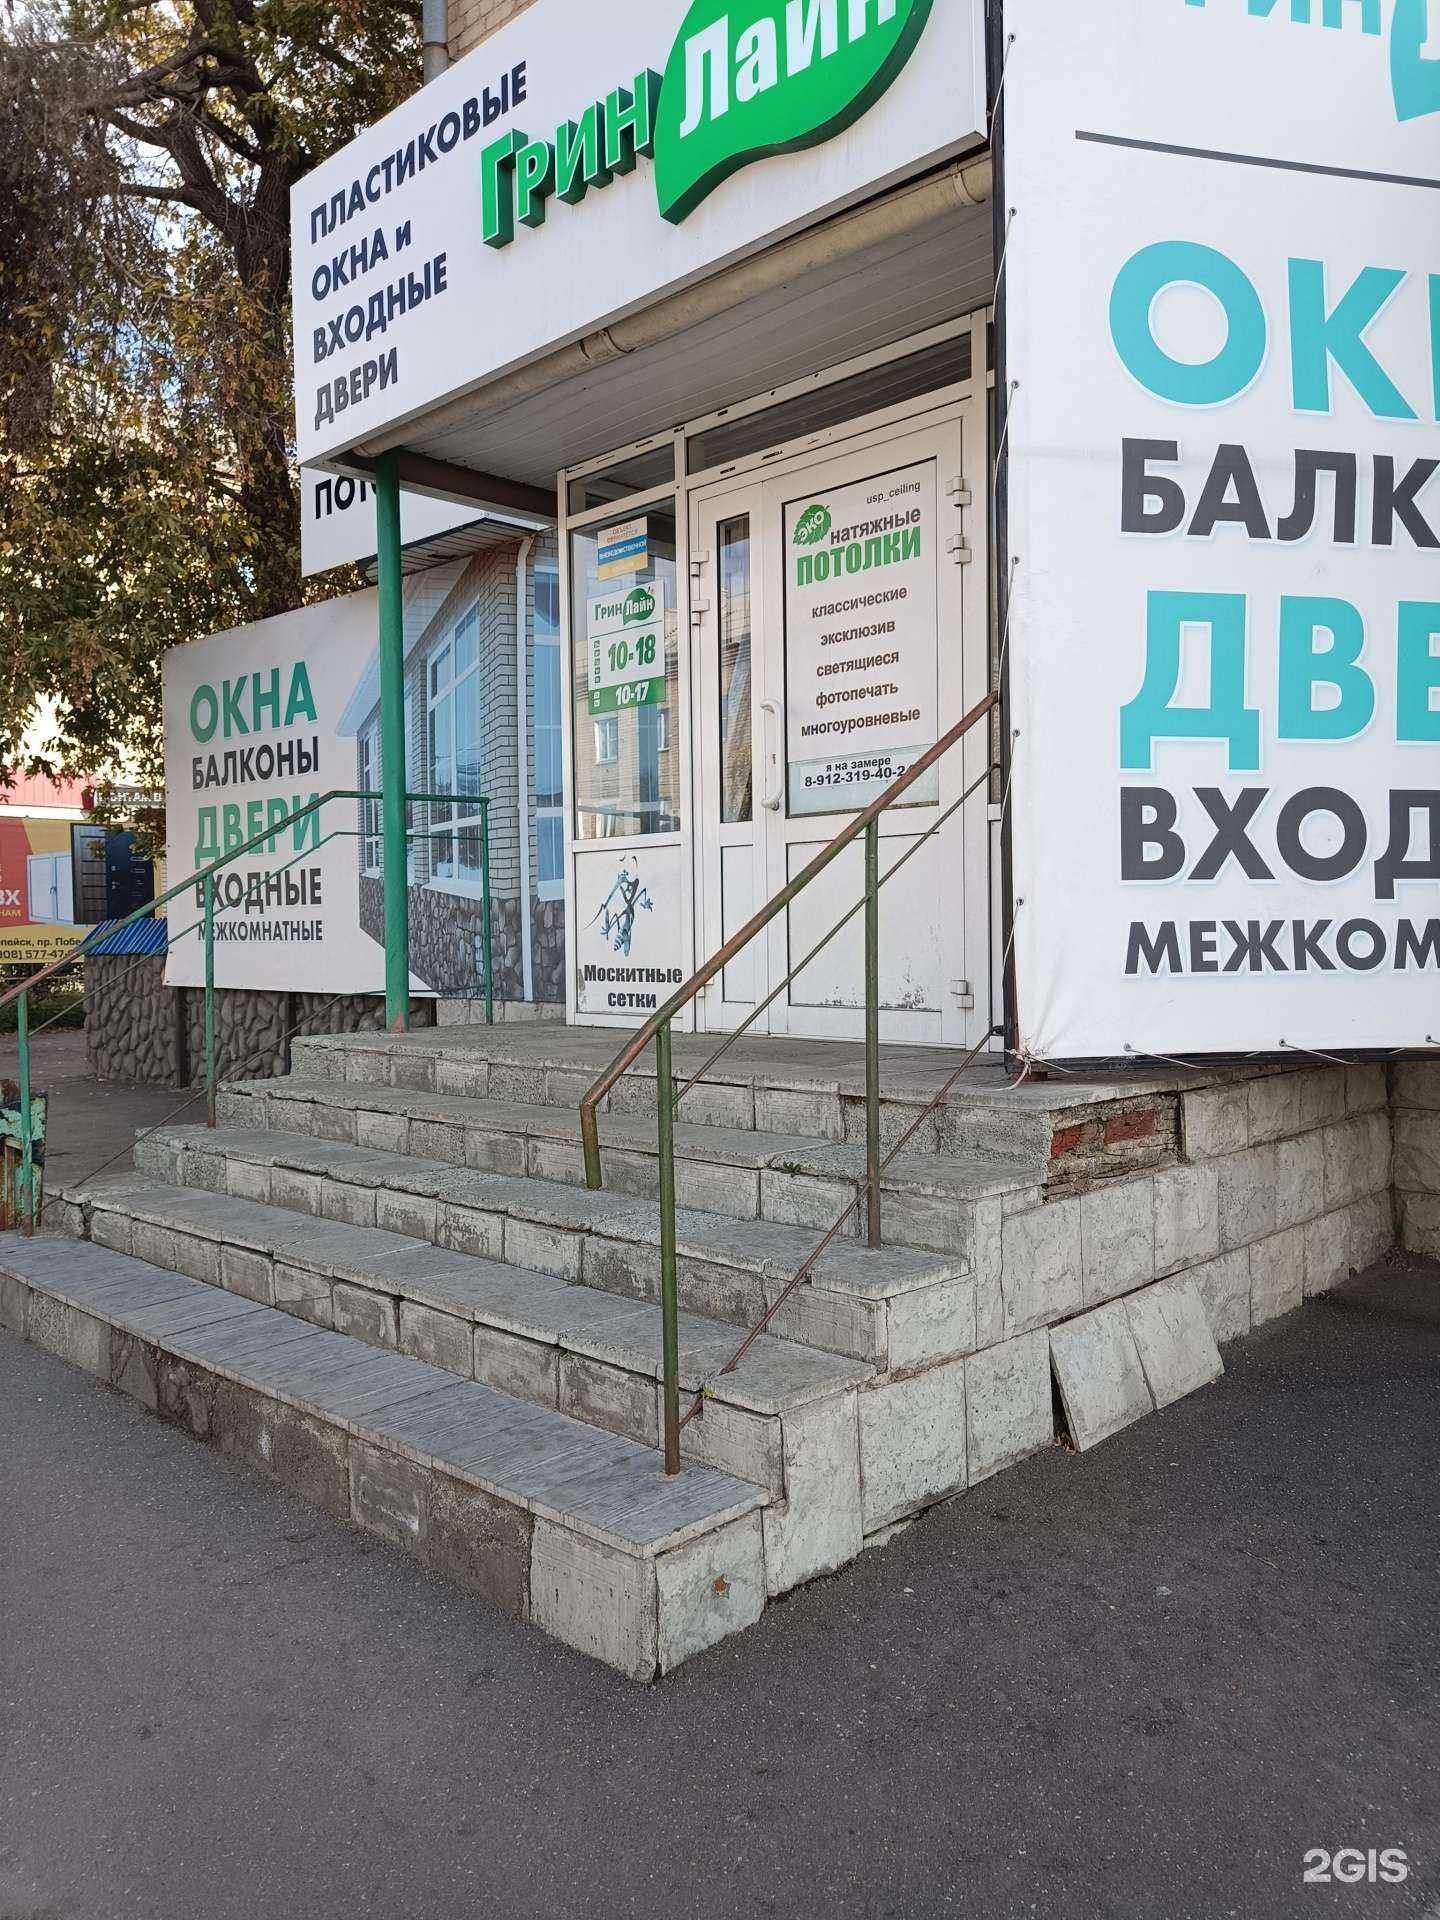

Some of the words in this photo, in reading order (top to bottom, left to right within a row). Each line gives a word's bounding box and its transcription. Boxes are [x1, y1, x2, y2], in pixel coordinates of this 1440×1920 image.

[311, 60, 527, 245] ПЛАСТИКОВЫЕ
[312, 227, 389, 301] ОКНА
[313, 252, 448, 364] ВХОДНЫЕ
[314, 347, 398, 431] ДВЕРИ
[866, 481, 921, 504] usp_ceiling
[831, 507, 921, 545] натяжные
[797, 525, 921, 587] ПОТОЛКИ
[811, 586, 908, 619] классические
[820, 620, 896, 646] эксклюзив
[608, 634, 656, 672] 10-18
[816, 651, 900, 677] светящиеся
[190, 661, 317, 743] ОКНА
[615, 681, 649, 706] 10-17
[815, 682, 899, 709] фотопечать
[801, 708, 921, 737] многоуровневые
[192, 736, 319, 790] БАЛКОНЫ
[804, 765, 912, 788] 8-912-319-40-2
[834, 761, 848, 772] на
[850, 756, 891, 769] замере
[194, 792, 320, 869] ДВЕРИ
[584, 964, 683, 984] Москитные
[607, 992, 657, 1009] сетки
